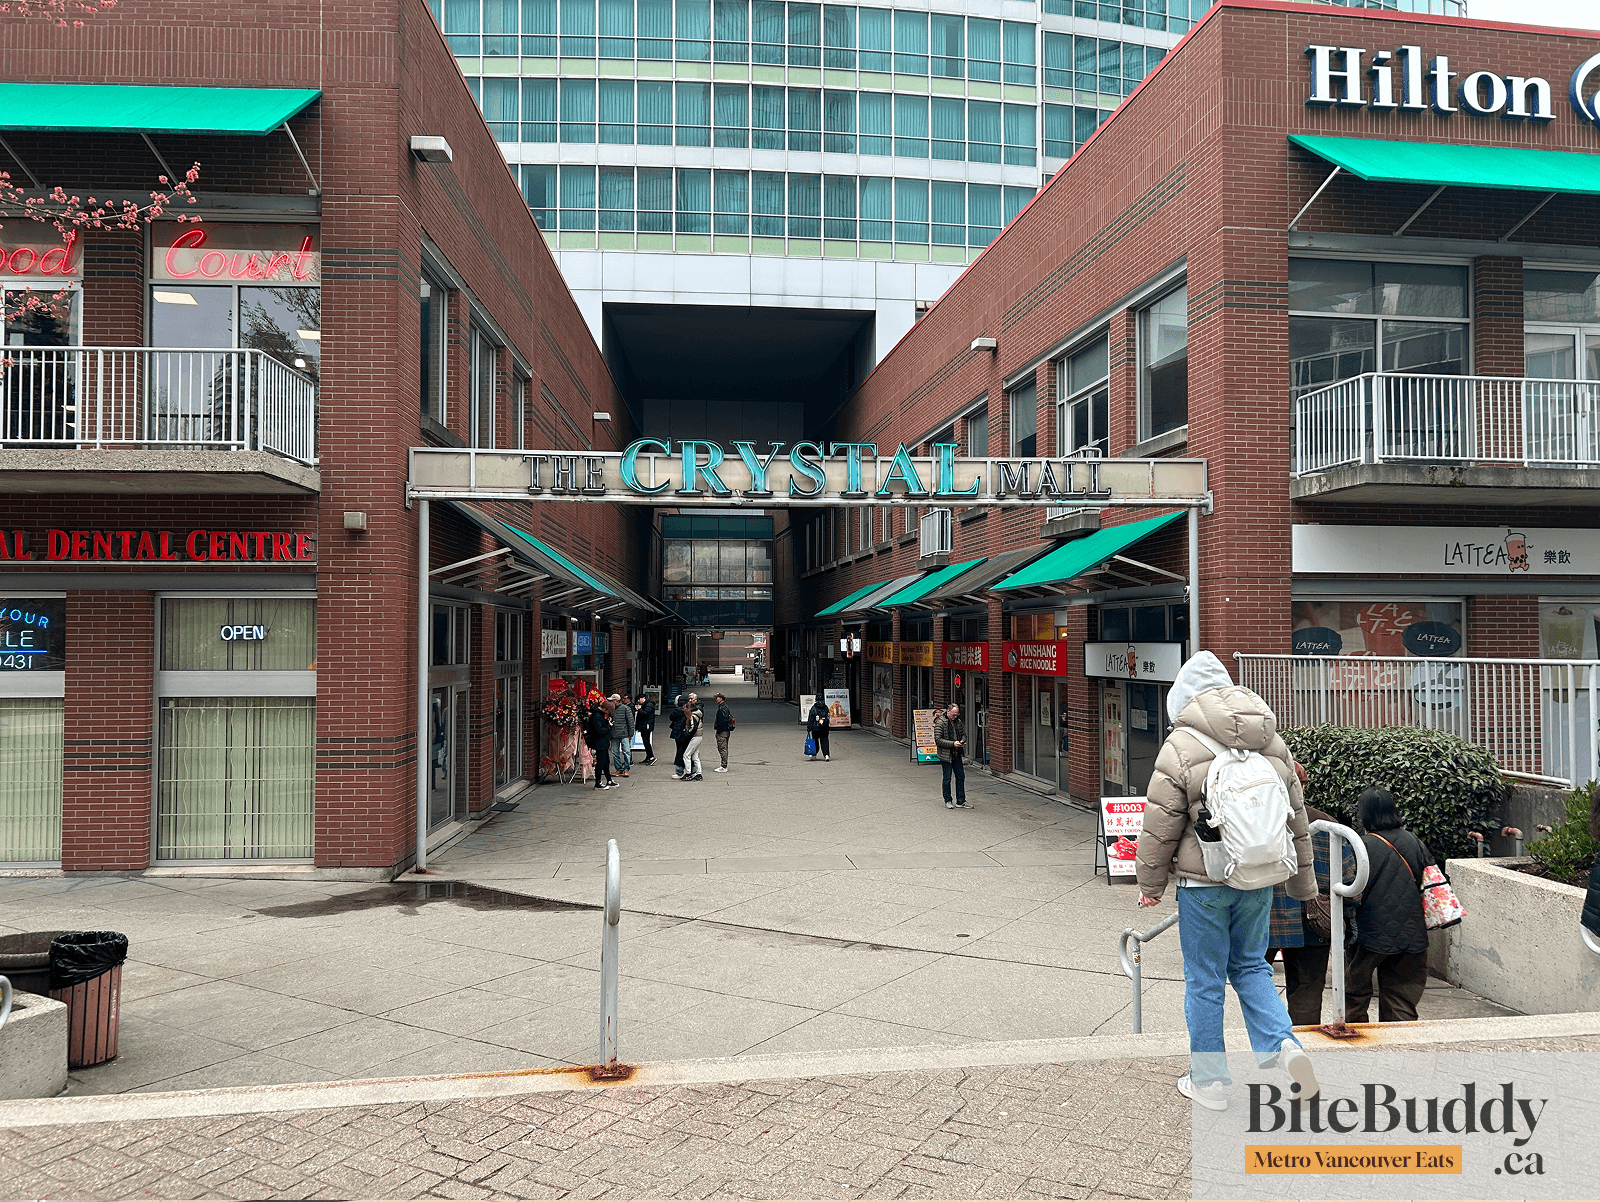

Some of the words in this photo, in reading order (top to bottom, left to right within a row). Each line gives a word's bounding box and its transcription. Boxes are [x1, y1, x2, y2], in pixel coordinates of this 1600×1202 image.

[1305, 44, 1556, 119] Hilton
[0, 229, 76, 274] od
[165, 229, 311, 280] Court
[523, 453, 606, 495] THE
[620, 437, 981, 499] CRYSTAL
[996, 460, 1112, 498] MALL
[45, 529, 177, 560] DENTAL
[185, 529, 314, 560] CENTRE
[1444, 541, 1508, 567] LATTEA
[1543, 550, 1571, 564] 樂飲
[220, 624, 265, 641] OPEN
[1416, 633, 1451, 645] LATTEA
[1019, 645, 1057, 658] YUNSHANG
[1295, 641, 1331, 651] LATTEA
[0, 655, 33, 669] 431
[1020, 659, 1032, 669] RICE
[1032, 660, 1057, 671] NOODLE
[1105, 653, 1128, 673] LATTEA
[1113, 804, 1143, 812] #1003
